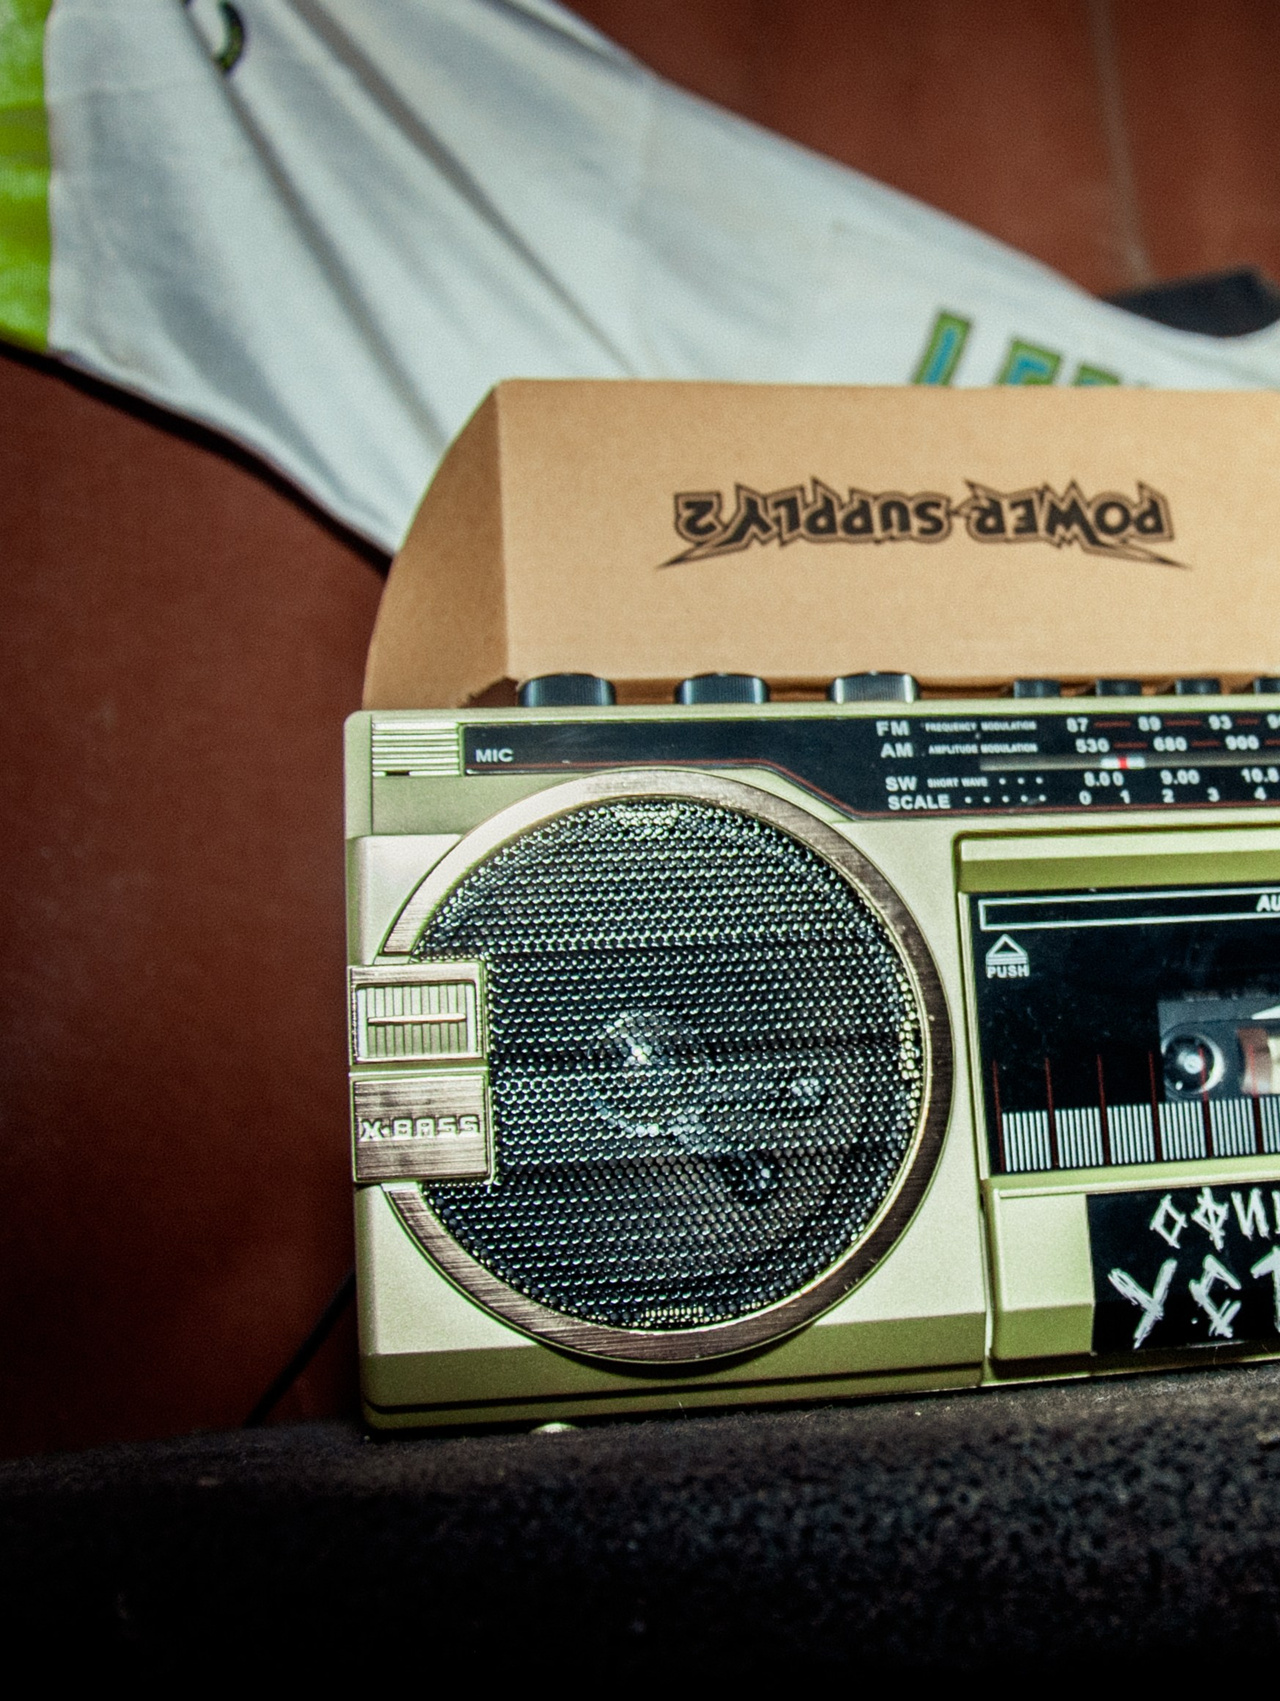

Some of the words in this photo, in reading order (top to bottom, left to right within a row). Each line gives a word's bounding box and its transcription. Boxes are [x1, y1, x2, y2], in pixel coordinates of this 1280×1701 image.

[964, 477, 1193, 570] POWER
[875, 720, 911, 737] FM
[924, 721, 978, 733] FREQUENCY
[980, 720, 1038, 732] MODULATION
[1066, 716, 1089, 733] 87
[1138, 715, 1162, 732] 89
[1208, 714, 1233, 730] 93
[475, 747, 515, 763] MIC
[880, 742, 914, 758] AM
[928, 743, 979, 755] AMPLITUDE
[980, 742, 1039, 754] MODULATION
[1075, 737, 1110, 754] 530
[1152, 736, 1188, 752] 680
[1224, 734, 1260, 751] 900
[884, 775, 918, 792] SW
[926, 777, 960, 789] SHORT
[960, 776, 989, 788] WAVE
[1083, 770, 1125, 787] 8.00
[1160, 769, 1201, 786] 9.00
[887, 793, 952, 812] SCALE
[1078, 789, 1093, 805] 0
[1120, 788, 1131, 804] 1
[1161, 787, 1175, 803] 2
[1206, 786, 1221, 802] 3
[1253, 785, 1268, 801] 4
[985, 965, 1031, 979] PUSH
